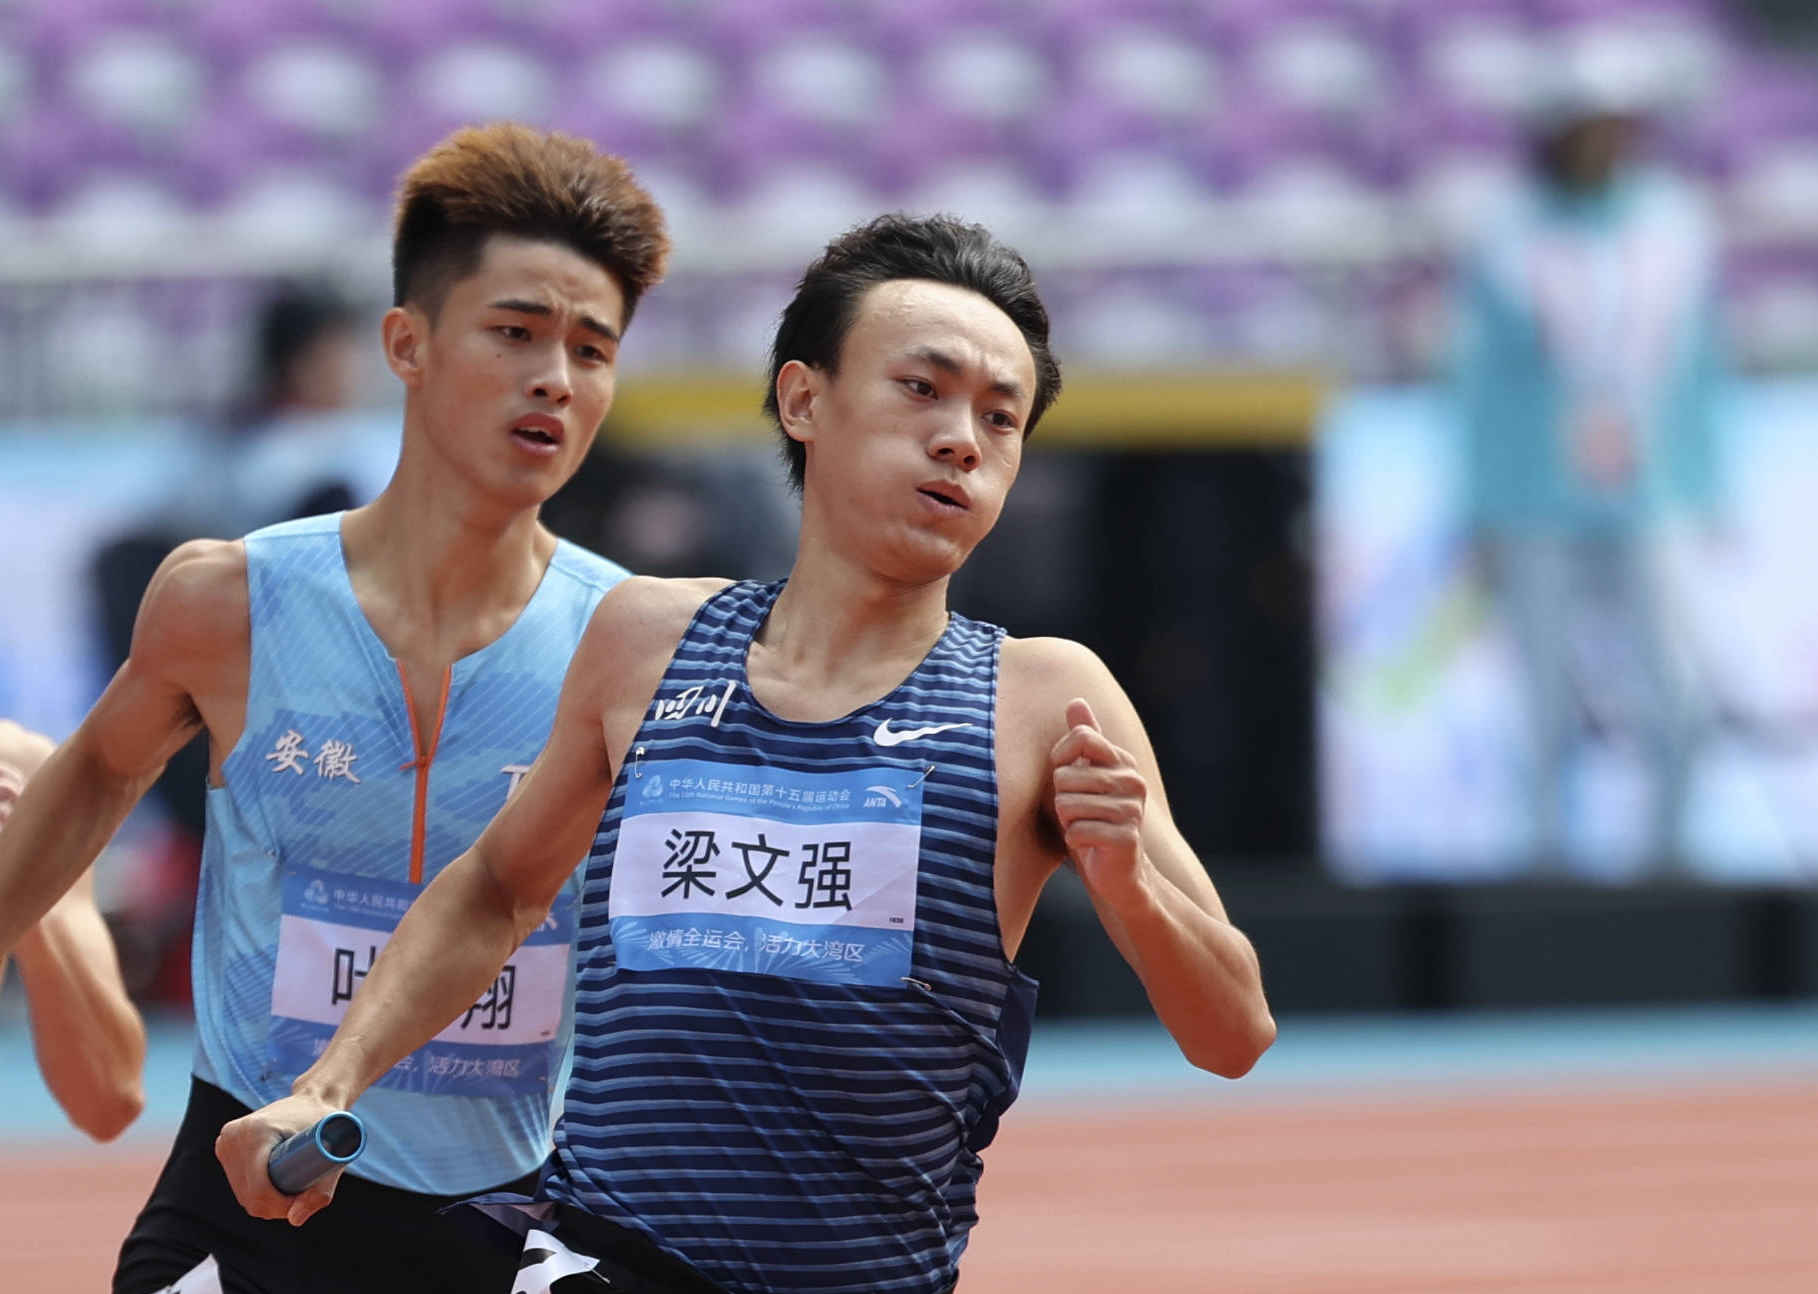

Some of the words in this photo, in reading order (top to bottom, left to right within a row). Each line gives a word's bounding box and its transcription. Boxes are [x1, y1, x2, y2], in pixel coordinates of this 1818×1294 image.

[265, 728, 362, 784] 安徽
[863, 797, 887, 808] ANTA
[661, 828, 853, 912] 梁文强
[331, 946, 516, 1029] 叶翔
